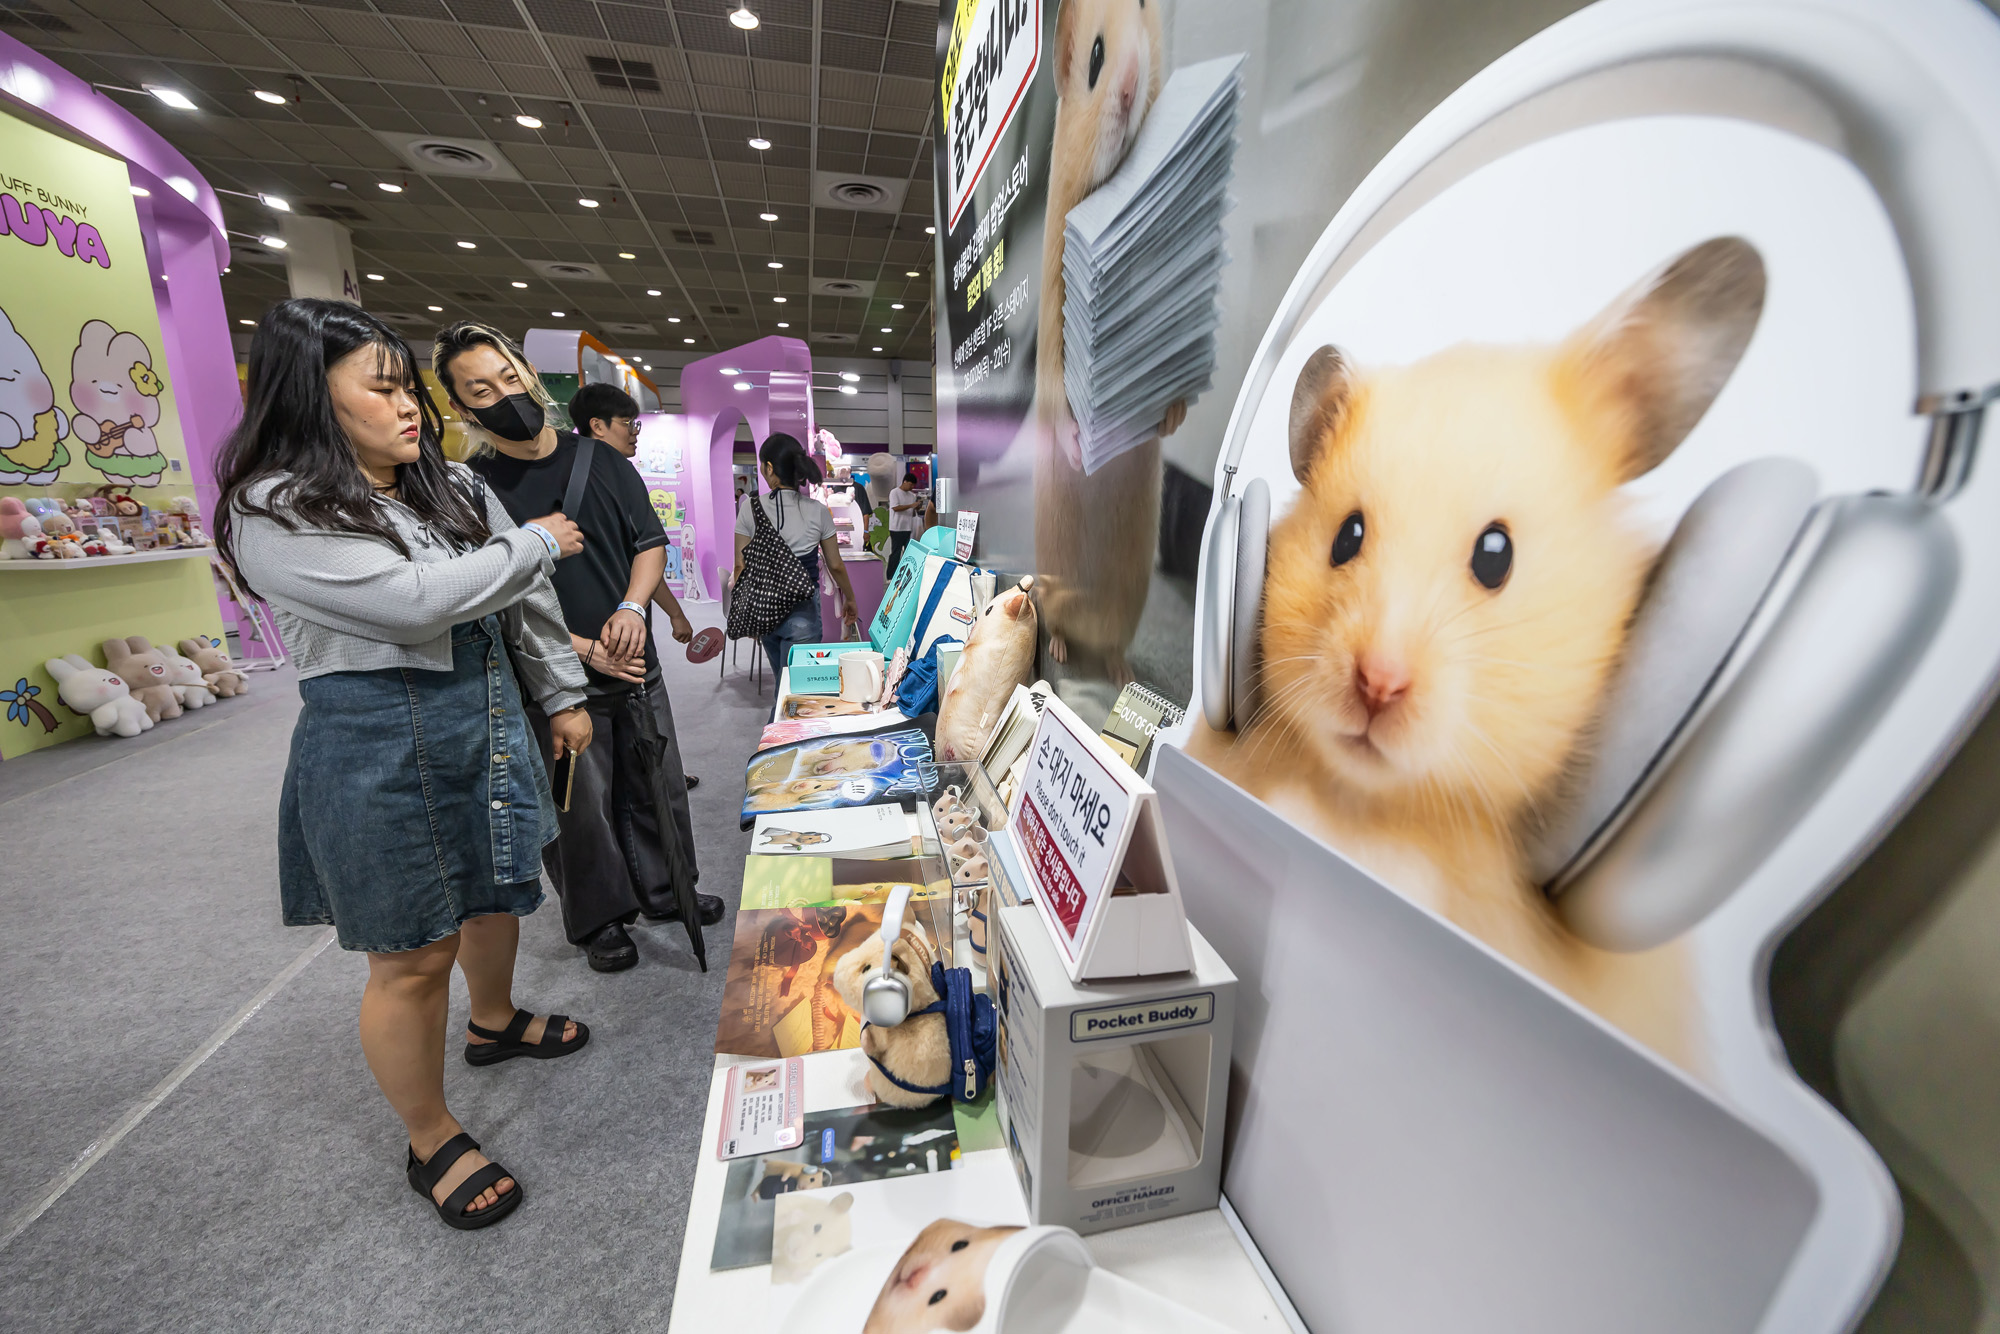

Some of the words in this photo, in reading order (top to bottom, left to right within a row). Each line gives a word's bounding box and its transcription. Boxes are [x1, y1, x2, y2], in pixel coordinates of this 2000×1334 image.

[37, 188, 87, 219] BUNNY
[0, 193, 111, 269] UYA
[992, 302, 1004, 332] 오픈
[1004, 273, 1029, 321] 스테이지
[993, 337, 1011, 370] 22(수)
[1121, 706, 1137, 725] OUT
[1134, 716, 1148, 731] OF
[1037, 734, 1051, 770] 손
[1049, 746, 1074, 799] 대지
[1070, 772, 1111, 848] 마세요
[1034, 779, 1050, 810] Please
[1047, 800, 1063, 832] don't
[1060, 824, 1080, 859] touch
[1078, 846, 1087, 868] it
[1043, 844, 1081, 913] 전시용입니다
[1087, 1012, 1144, 1032] Pocket
[1148, 1004, 1198, 1024] Buddy
[788, 1062, 798, 1087] OFFICIAL
[1091, 1194, 1131, 1208] OFFICE
[1133, 1185, 1175, 1201] HAMZZI
